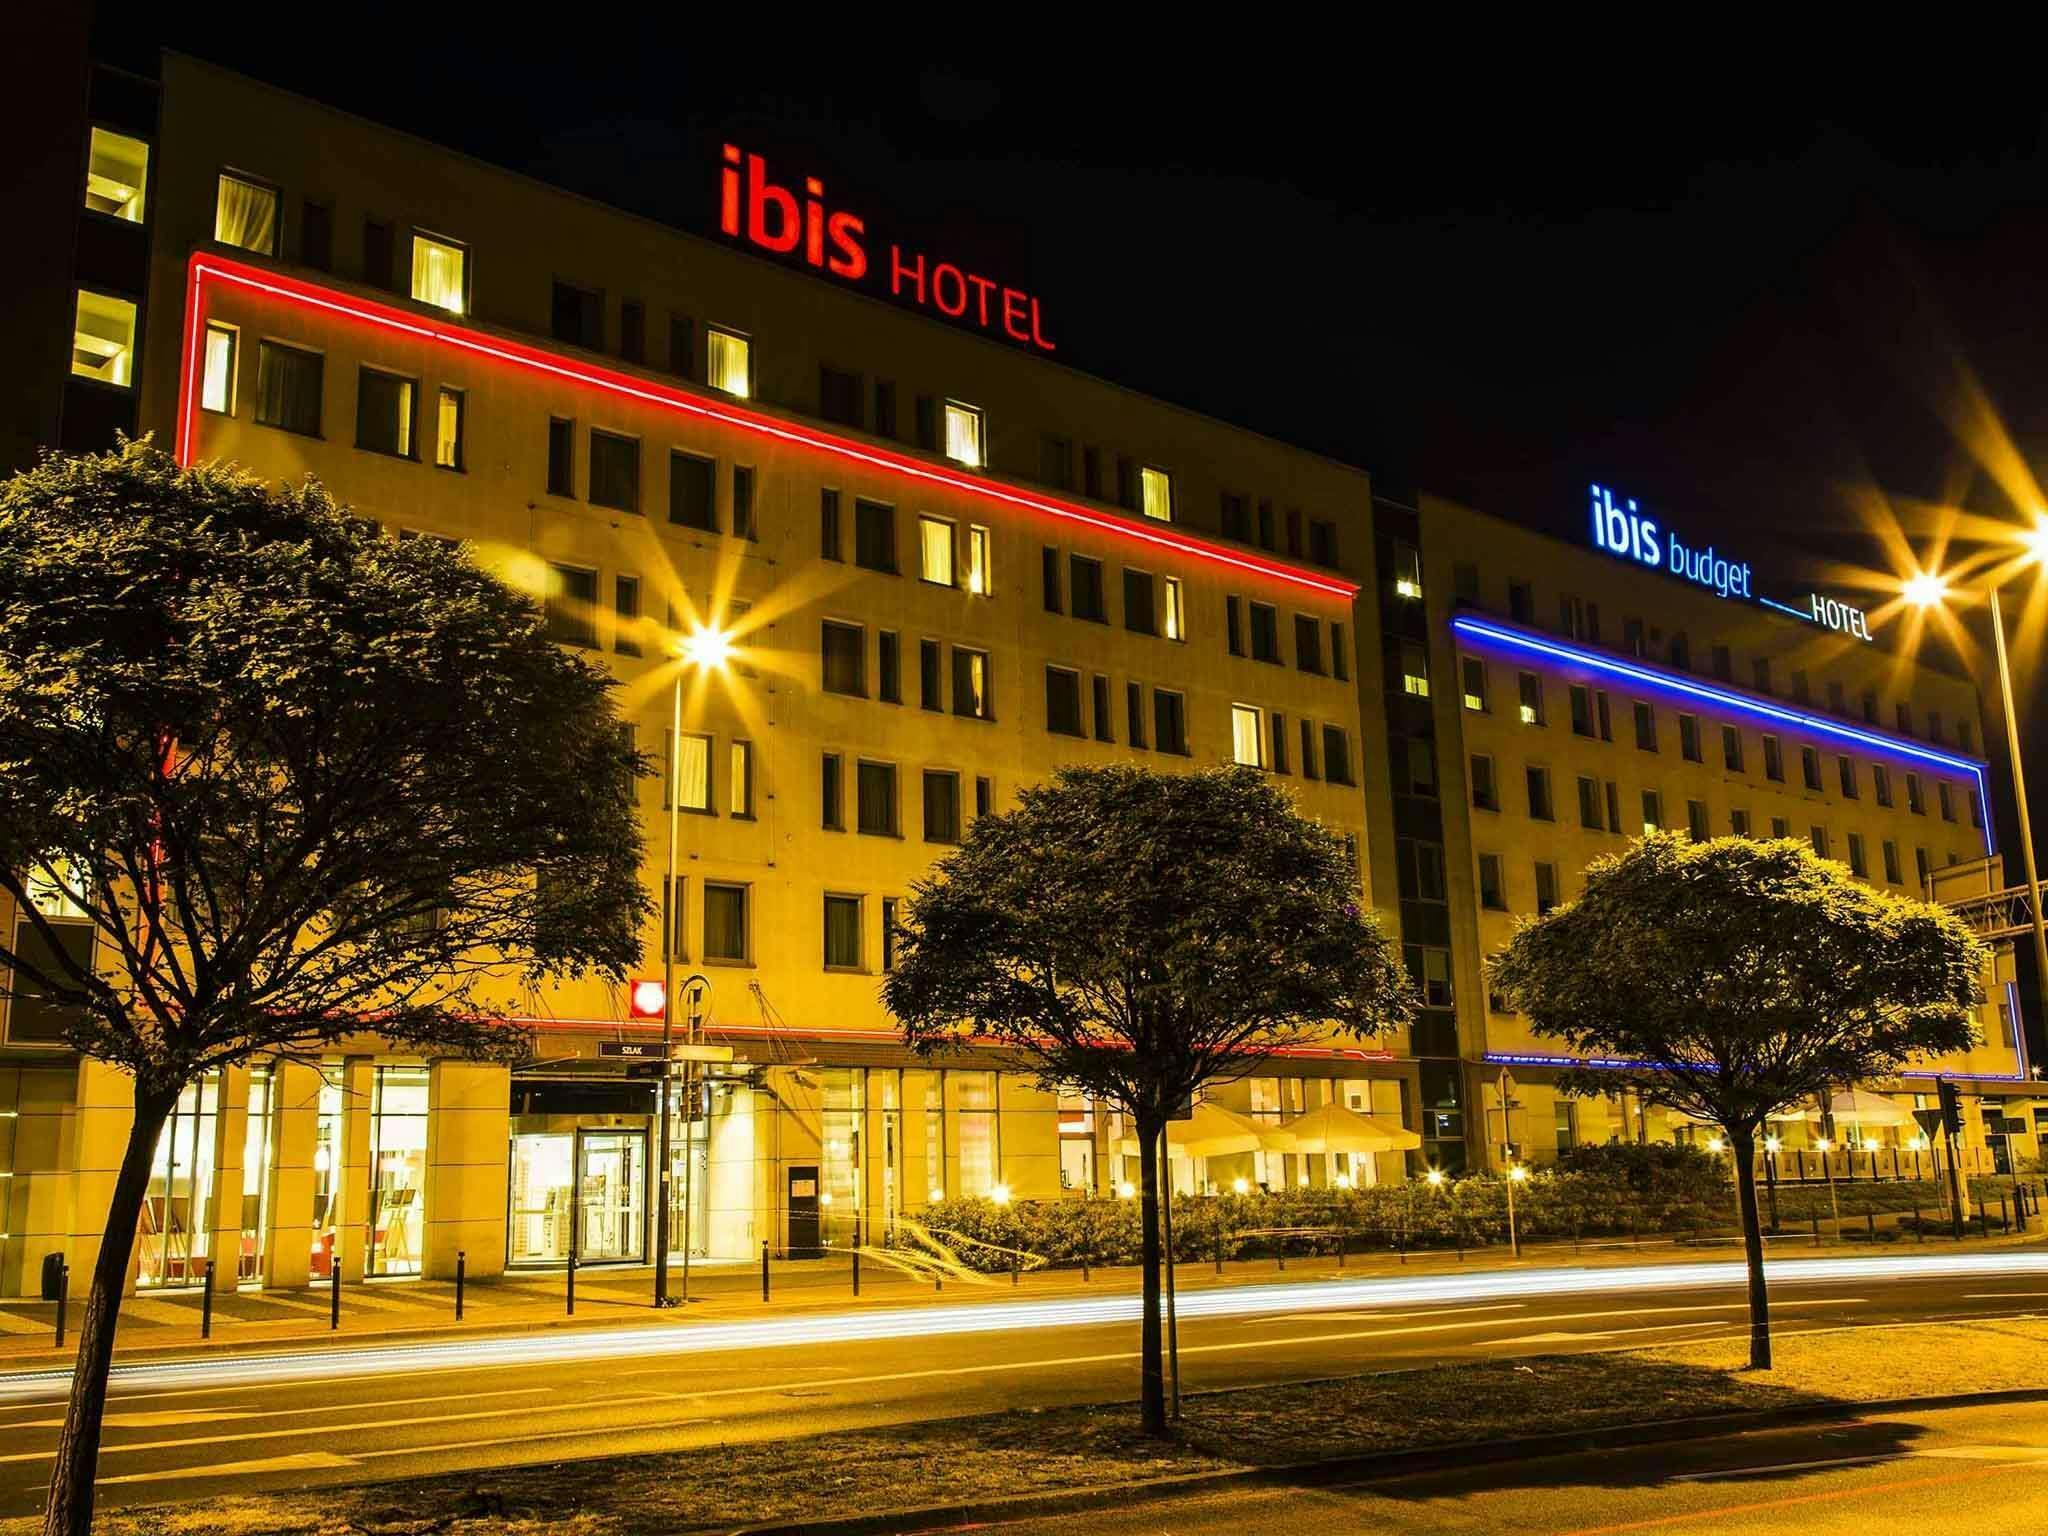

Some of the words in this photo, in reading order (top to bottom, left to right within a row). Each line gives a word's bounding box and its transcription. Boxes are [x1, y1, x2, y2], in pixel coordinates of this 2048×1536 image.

[721, 143, 867, 279] ibis
[890, 245, 1056, 350] HOTEL
[1591, 484, 1660, 566] ibis
[1669, 533, 1751, 598] budget
[1810, 593, 1873, 642] HOTEL
